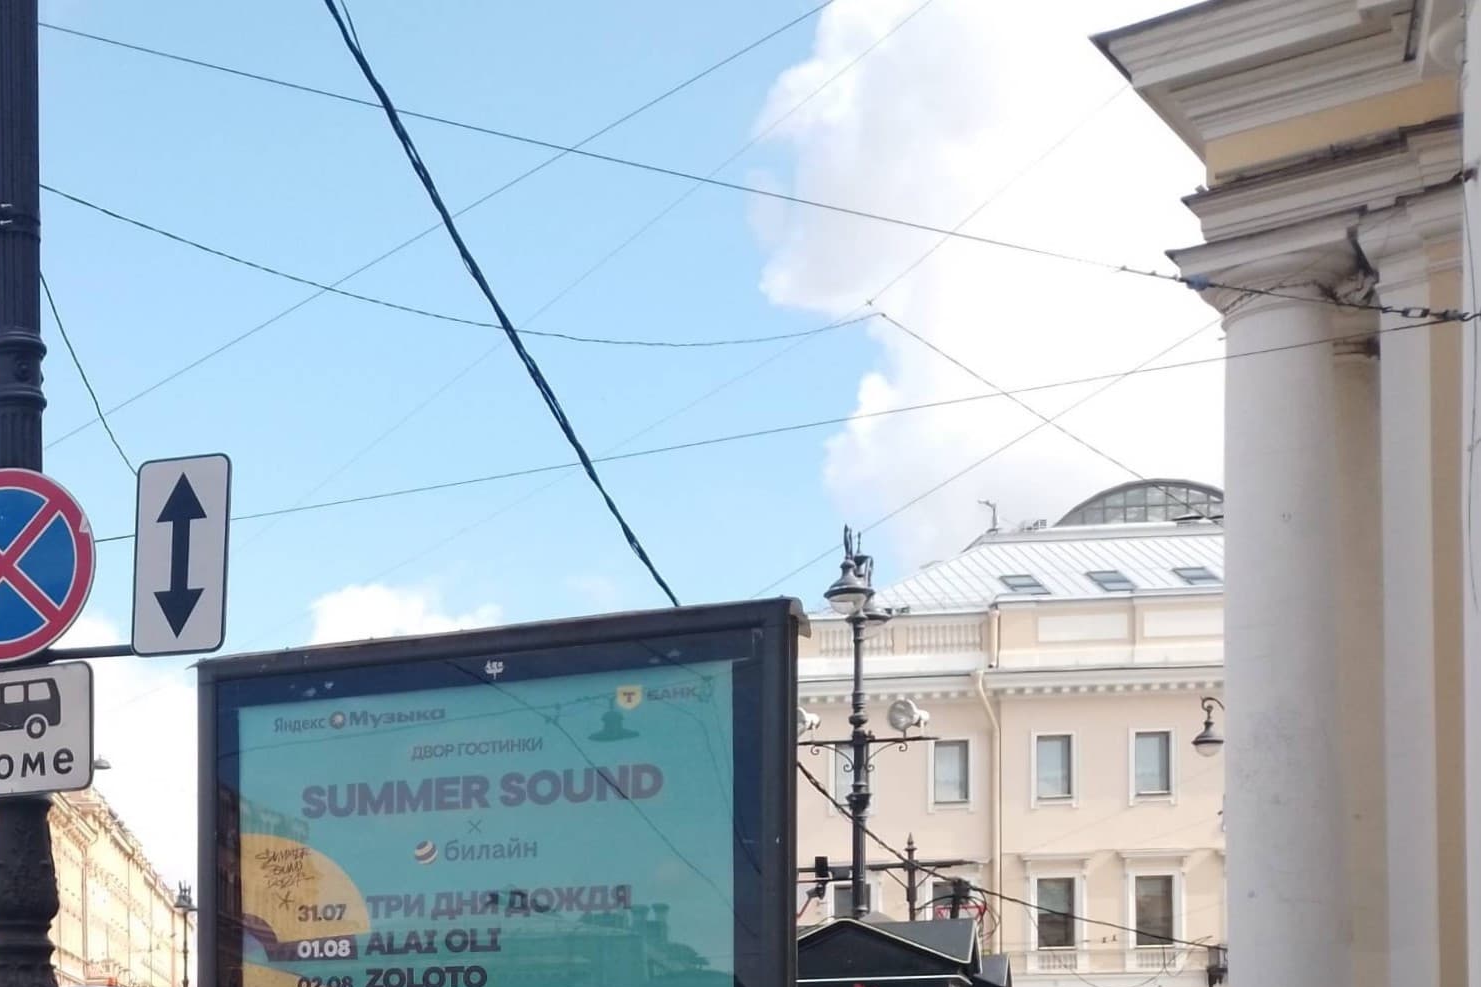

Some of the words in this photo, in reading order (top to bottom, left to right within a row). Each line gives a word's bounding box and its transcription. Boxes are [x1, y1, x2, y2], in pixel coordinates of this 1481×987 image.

[274, 717, 326, 733] Яндекс
[349, 708, 446, 728] Музыка
[411, 745, 454, 761] ДВОР
[458, 737, 543, 756] ГОСТИНКИ
[301, 775, 491, 820] SUMMER
[500, 763, 664, 807] SOUND
[444, 837, 538, 861] билайн
[297, 904, 347, 922] 31.07
[367, 893, 426, 919] ТРИ
[431, 890, 496, 920] ДНЯ
[505, 885, 632, 916] ДОЖДЯ
[297, 940, 351, 958] 01.08
[365, 930, 437, 955] ALAI
[445, 928, 501, 953] OLI
